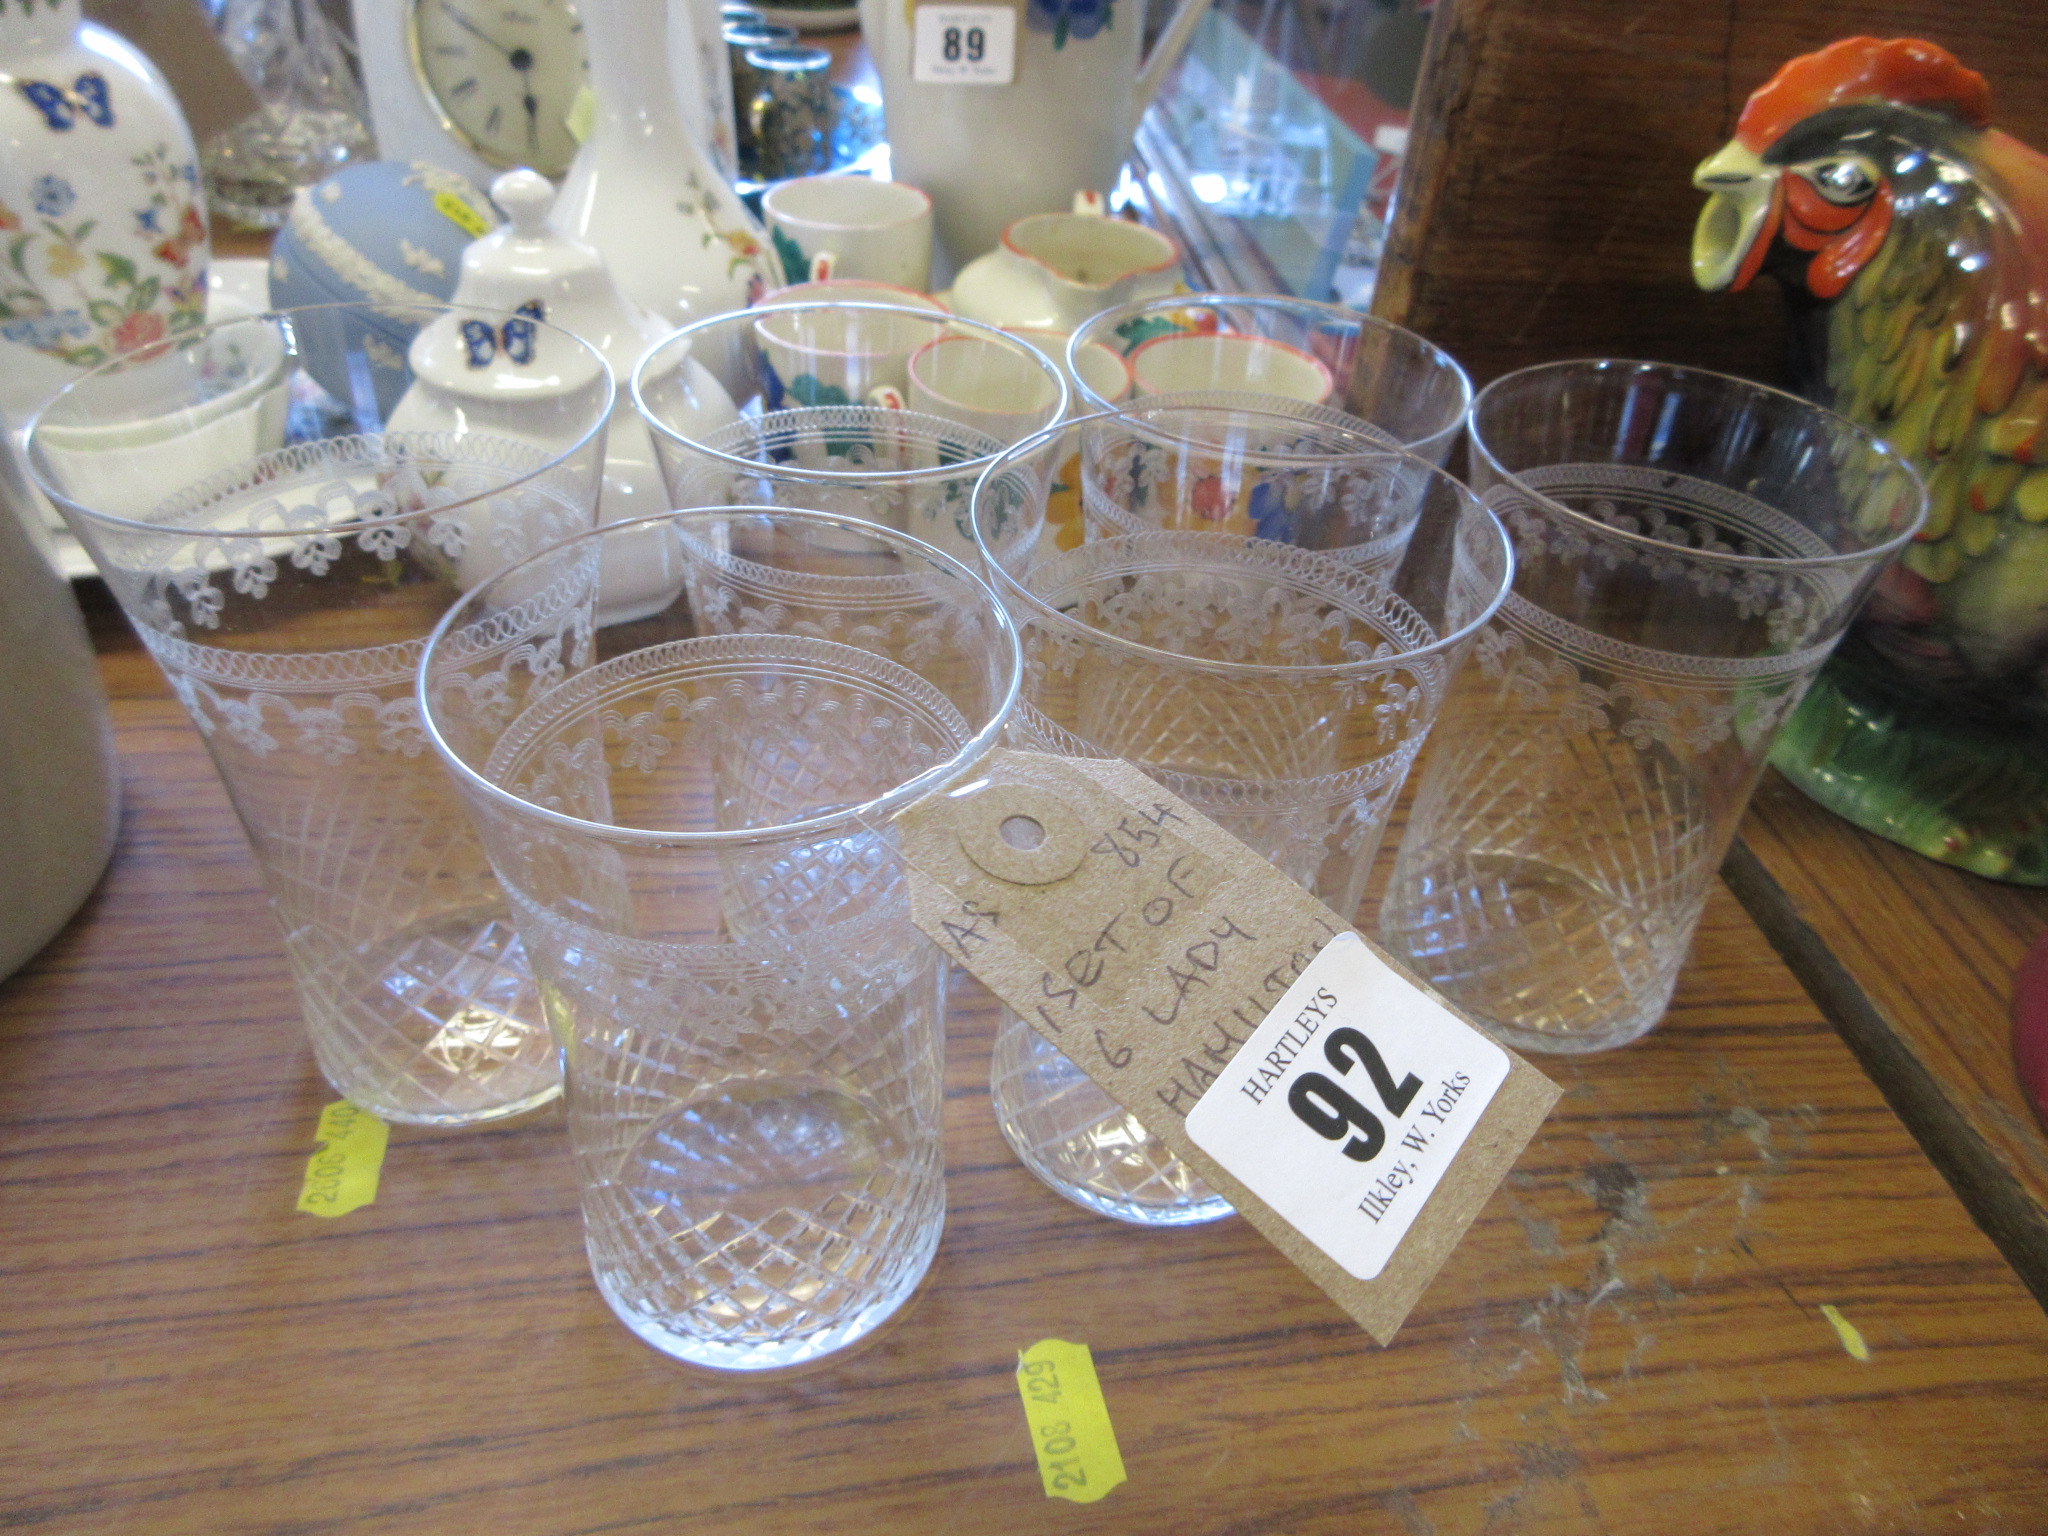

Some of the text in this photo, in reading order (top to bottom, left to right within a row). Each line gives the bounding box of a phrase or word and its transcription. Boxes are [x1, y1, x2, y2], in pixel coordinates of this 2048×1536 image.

[944, 27, 984, 62] 89
[1089, 803, 1189, 868] 854
[1042, 906, 1127, 1010] SET
[1142, 855, 1196, 927] OF
[1094, 916, 1257, 1069] 6 LADY
[1240, 986, 1339, 1106] HARTLEYS
[1287, 1026, 1424, 1163] 92
[1356, 1070, 1471, 1225] Ilkley, W. Yorks
[1024, 1359, 1088, 1490] 2108 429
